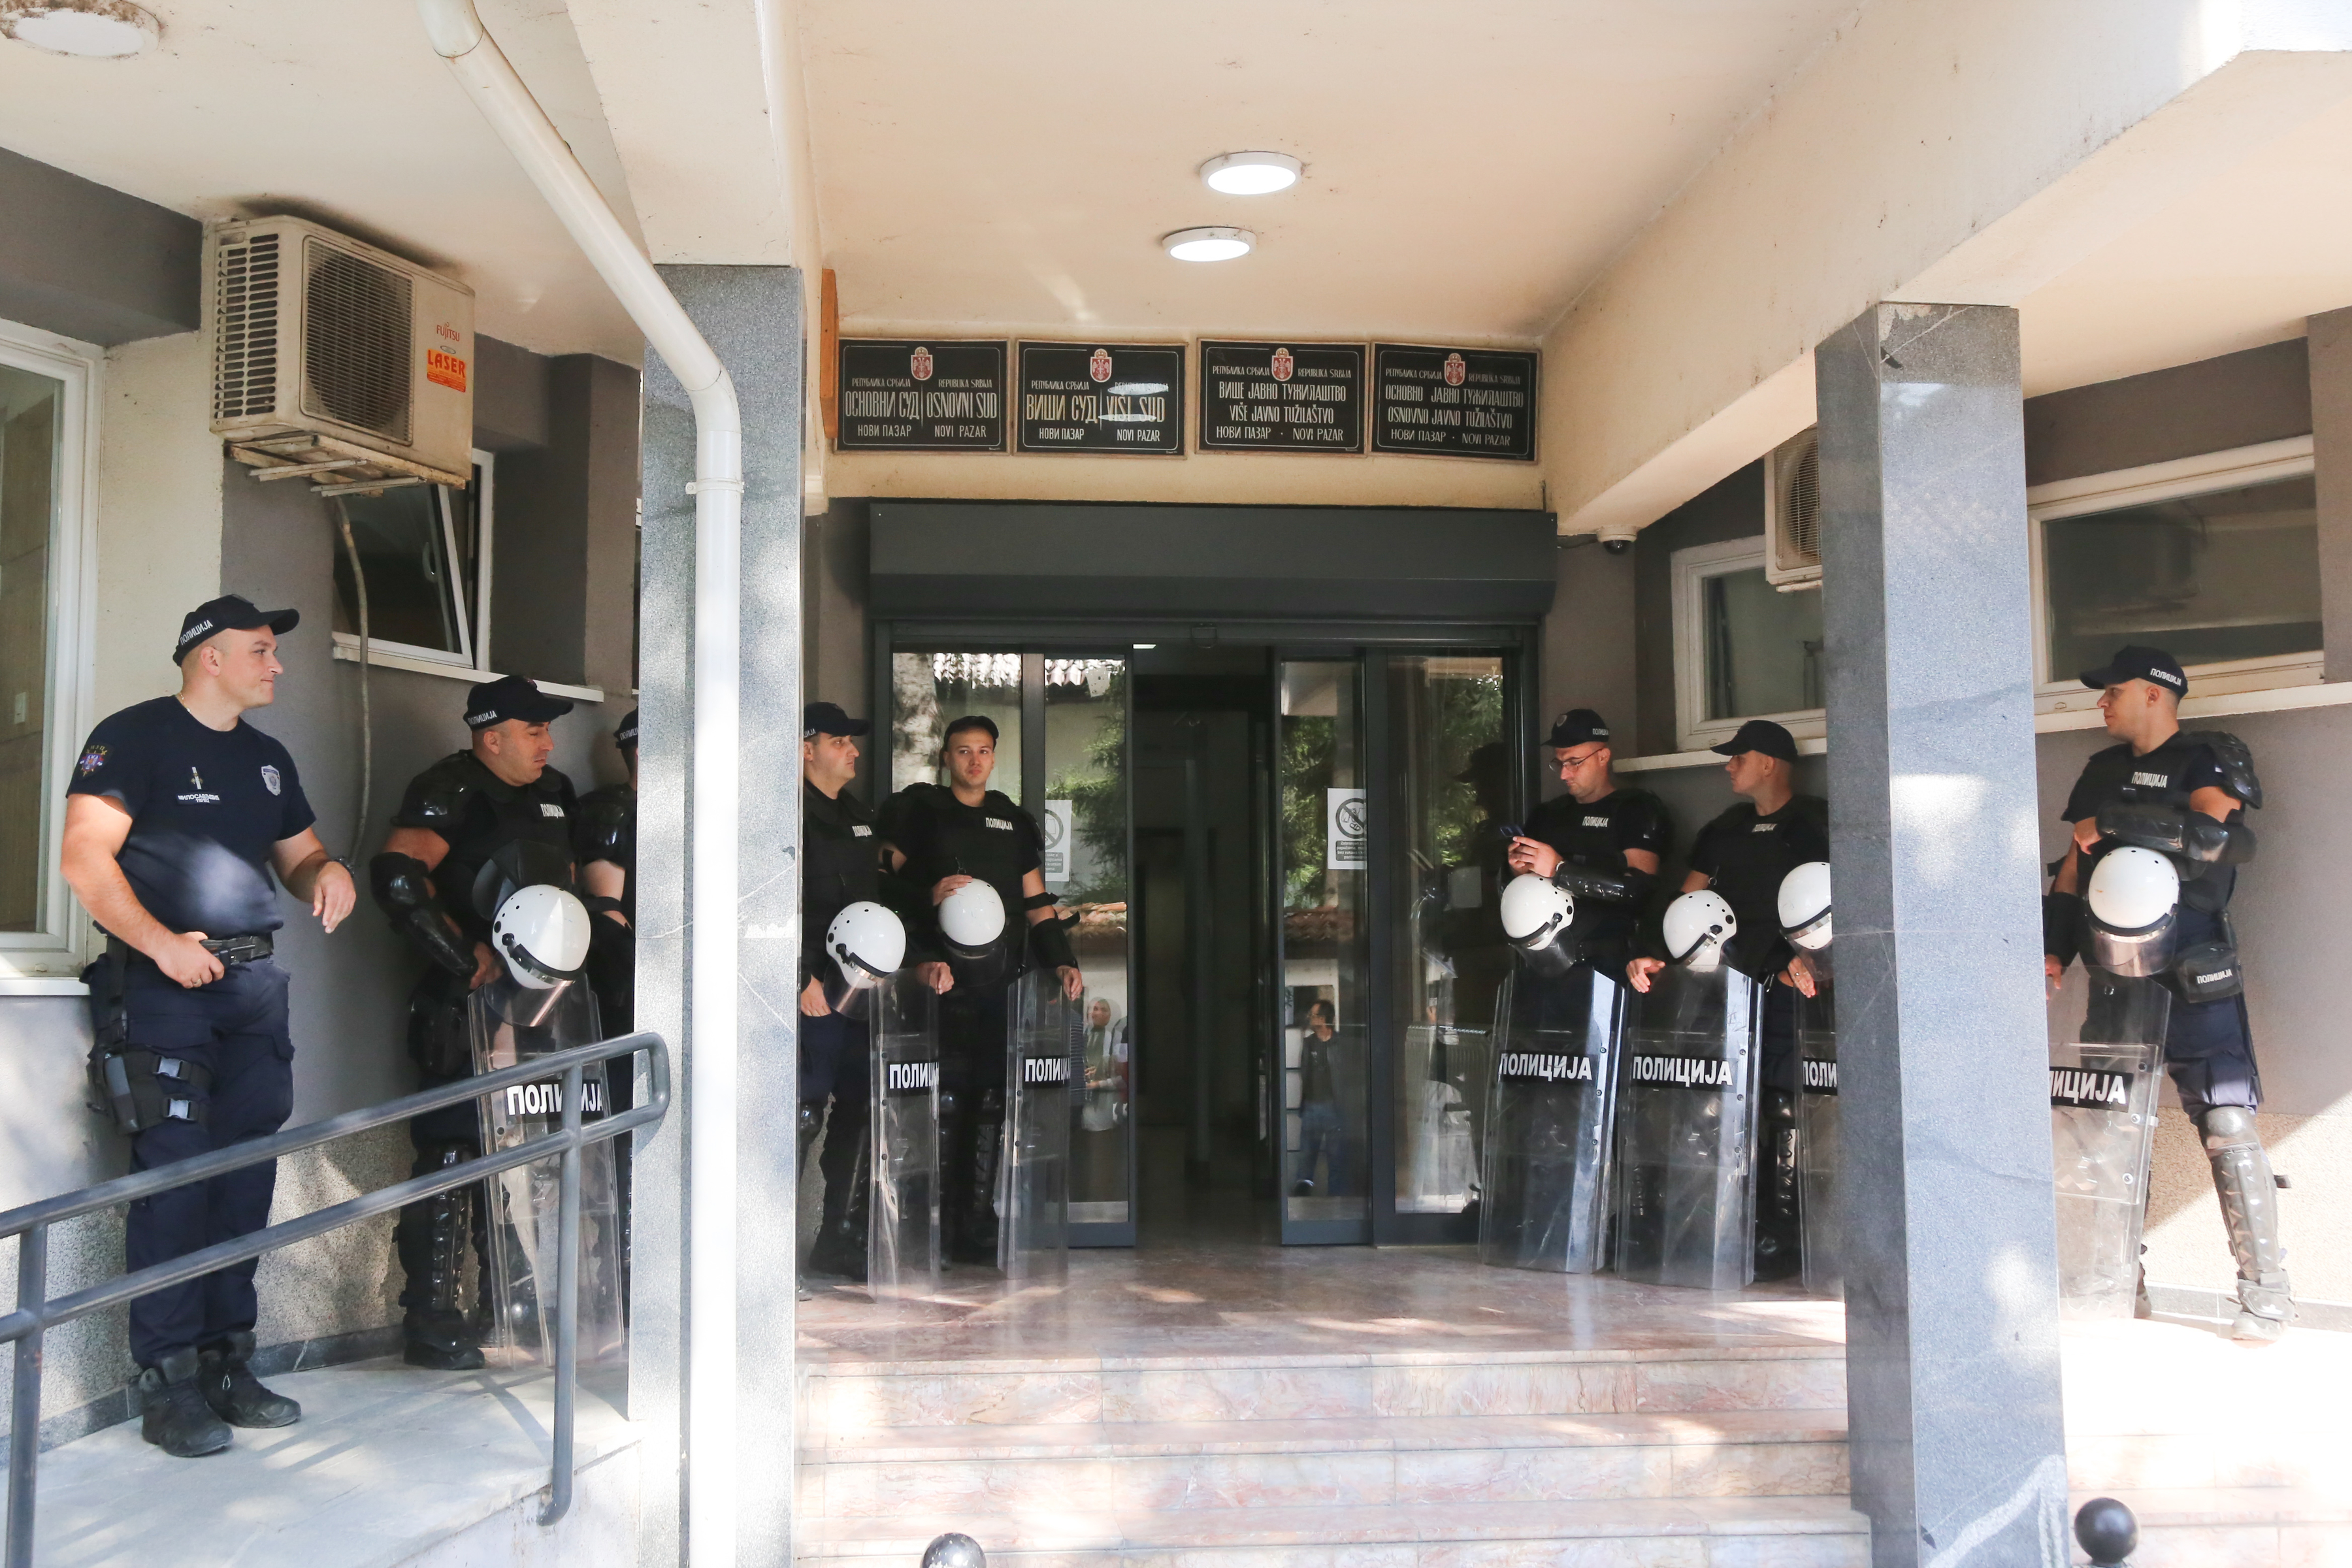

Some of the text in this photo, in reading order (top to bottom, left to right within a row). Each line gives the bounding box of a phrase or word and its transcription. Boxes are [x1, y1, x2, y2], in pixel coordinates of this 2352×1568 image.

[436, 323, 460, 342] FUJITSU
[428, 350, 466, 378] LASER
[1213, 366, 1270, 376] РЕПУБЛИКА СРБИЈА
[1298, 368, 1351, 378] REPUBLIKA SRBIJA
[1386, 368, 1442, 380] РЕПУБЛИКА СРБИЈА
[852, 378, 911, 387] РЕПУБЛИКА СРБИЈА
[938, 379, 992, 388] REPUBLIKA SRBIJA
[1032, 380, 1089, 390] РЕПУБЛИКА СРБИЈА
[1219, 382, 1346, 401] ВИШЕ ЈАВНО ТУЖИЛАШТВО
[1385, 384, 1523, 407] ОСНОВНО ЈАВНО ТУЖИЛАШТВО
[845, 391, 920, 419] ОСНОВНИ СУД
[926, 392, 997, 418] OSNOVNI SUD
[1026, 395, 1098, 423] ВИШИ СУД
[1139, 397, 1165, 422] SUD
[1230, 402, 1333, 423] VIŠE JAVNO TUŽILAŠTVO
[1388, 406, 1512, 429] OSNOVNO JAVNO TUŽILAŠTVO
[858, 425, 911, 436] НОВИ ПАЗАР
[935, 425, 987, 438] NOVI PAZAR
[1039, 428, 1084, 440] НОВИ ПАЗАР
[1117, 429, 1160, 442] NOVI PAZAR
[1217, 427, 1271, 439] НОВИ ПАЗАР
[1293, 428, 1343, 441] NOVI PAZAR
[1391, 429, 1446, 442] НОВИ ПАЗАР
[1462, 433, 1511, 446] NOVI PAZAR
[180, 619, 213, 645] ПОЛИЦИЈА
[2150, 668, 2181, 686] ПОЛИЦИЈА
[2131, 772, 2168, 788] ПОЛИЦИЈА
[985, 817, 1013, 830] ПОЛИЦИЈА
[2197, 968, 2233, 984] ПОЛИЦИЈА
[1499, 1053, 1592, 1082] ПОЛИЦИЈА
[1633, 1056, 1733, 1087] ПОЛИЦИЈА
